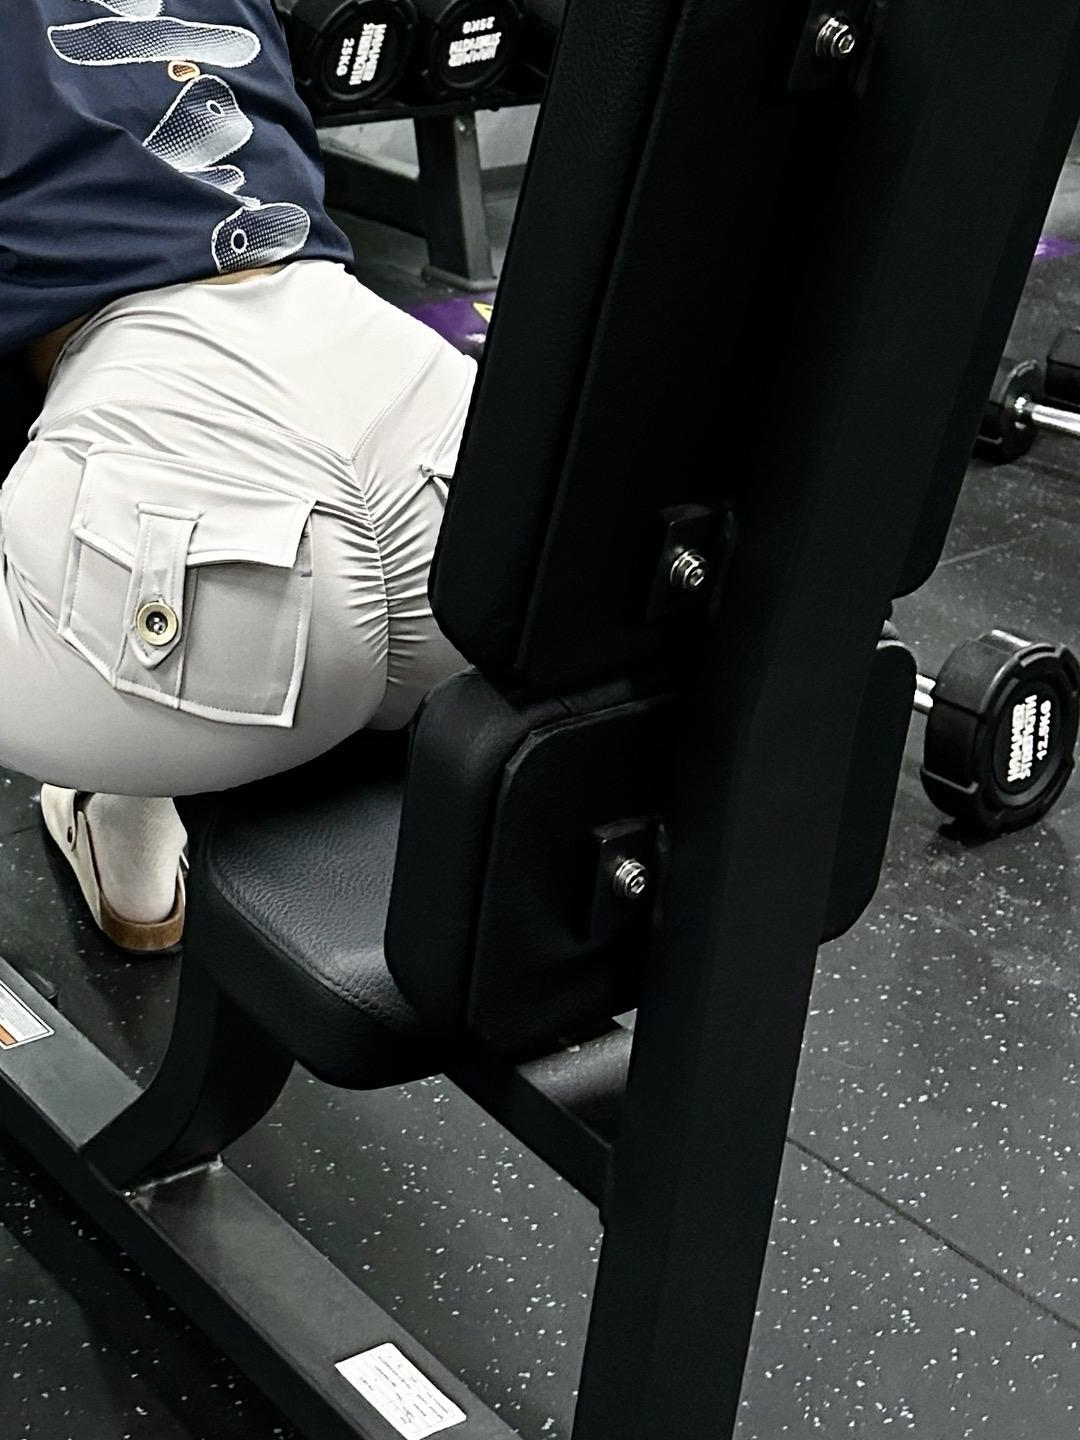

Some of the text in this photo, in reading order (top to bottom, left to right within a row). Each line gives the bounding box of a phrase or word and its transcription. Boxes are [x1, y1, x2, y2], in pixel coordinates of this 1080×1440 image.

[336, 37, 355, 76] 25KG
[1007, 703, 1026, 782] HAMMER
[1020, 694, 1038, 779] STRENGTH
[1036, 700, 1051, 760] 12.5KG
